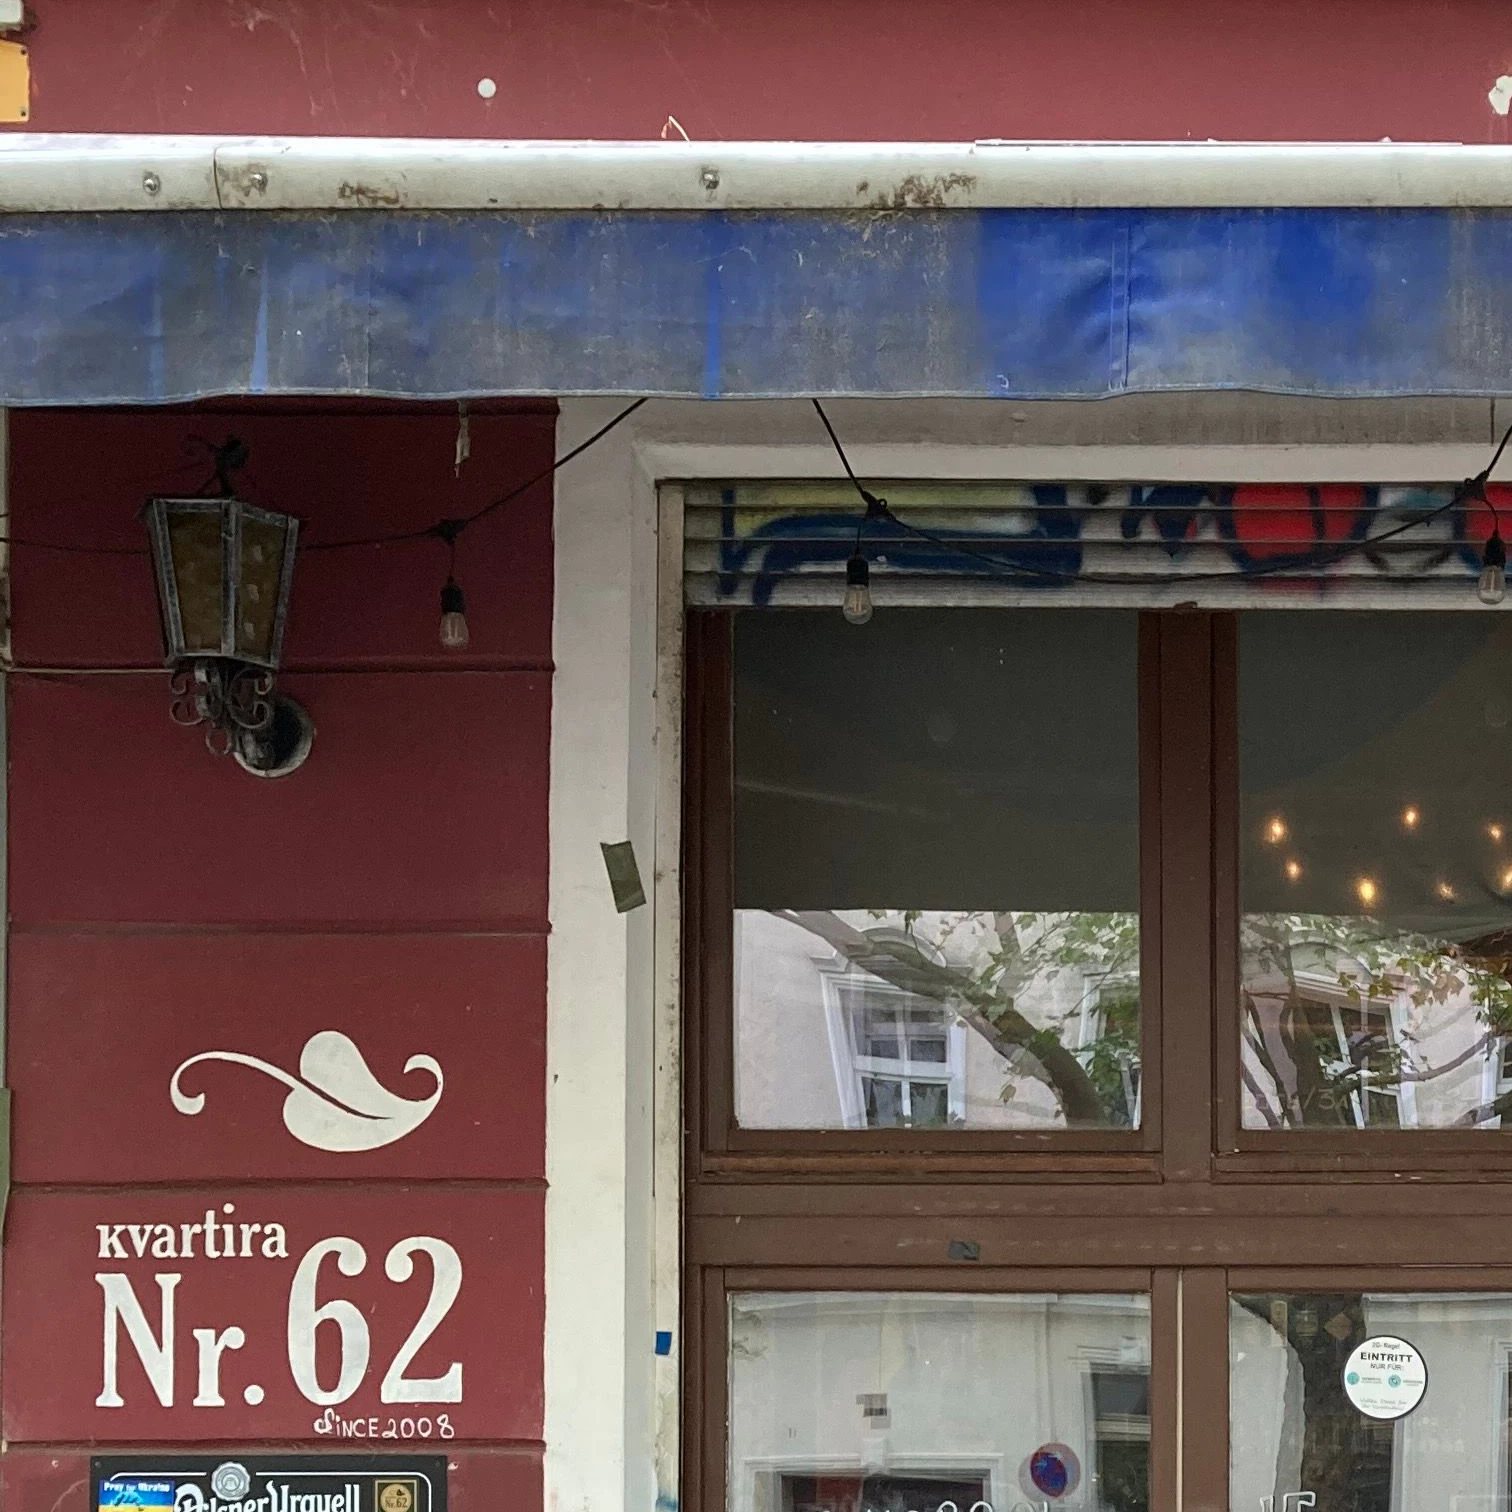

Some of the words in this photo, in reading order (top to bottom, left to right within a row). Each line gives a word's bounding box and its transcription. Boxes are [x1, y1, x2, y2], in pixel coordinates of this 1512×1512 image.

[95, 1202, 289, 1260] kvartira
[95, 1272, 265, 1408] Nr.
[287, 1236, 464, 1406] 62
[1360, 1351, 1413, 1363] EINTRITT
[1370, 1362, 1386, 1370] NUR
[382, 1414, 455, 1440] 2008
[103, 1481, 124, 1493] Pray
[137, 1481, 171, 1493] Ukraine
